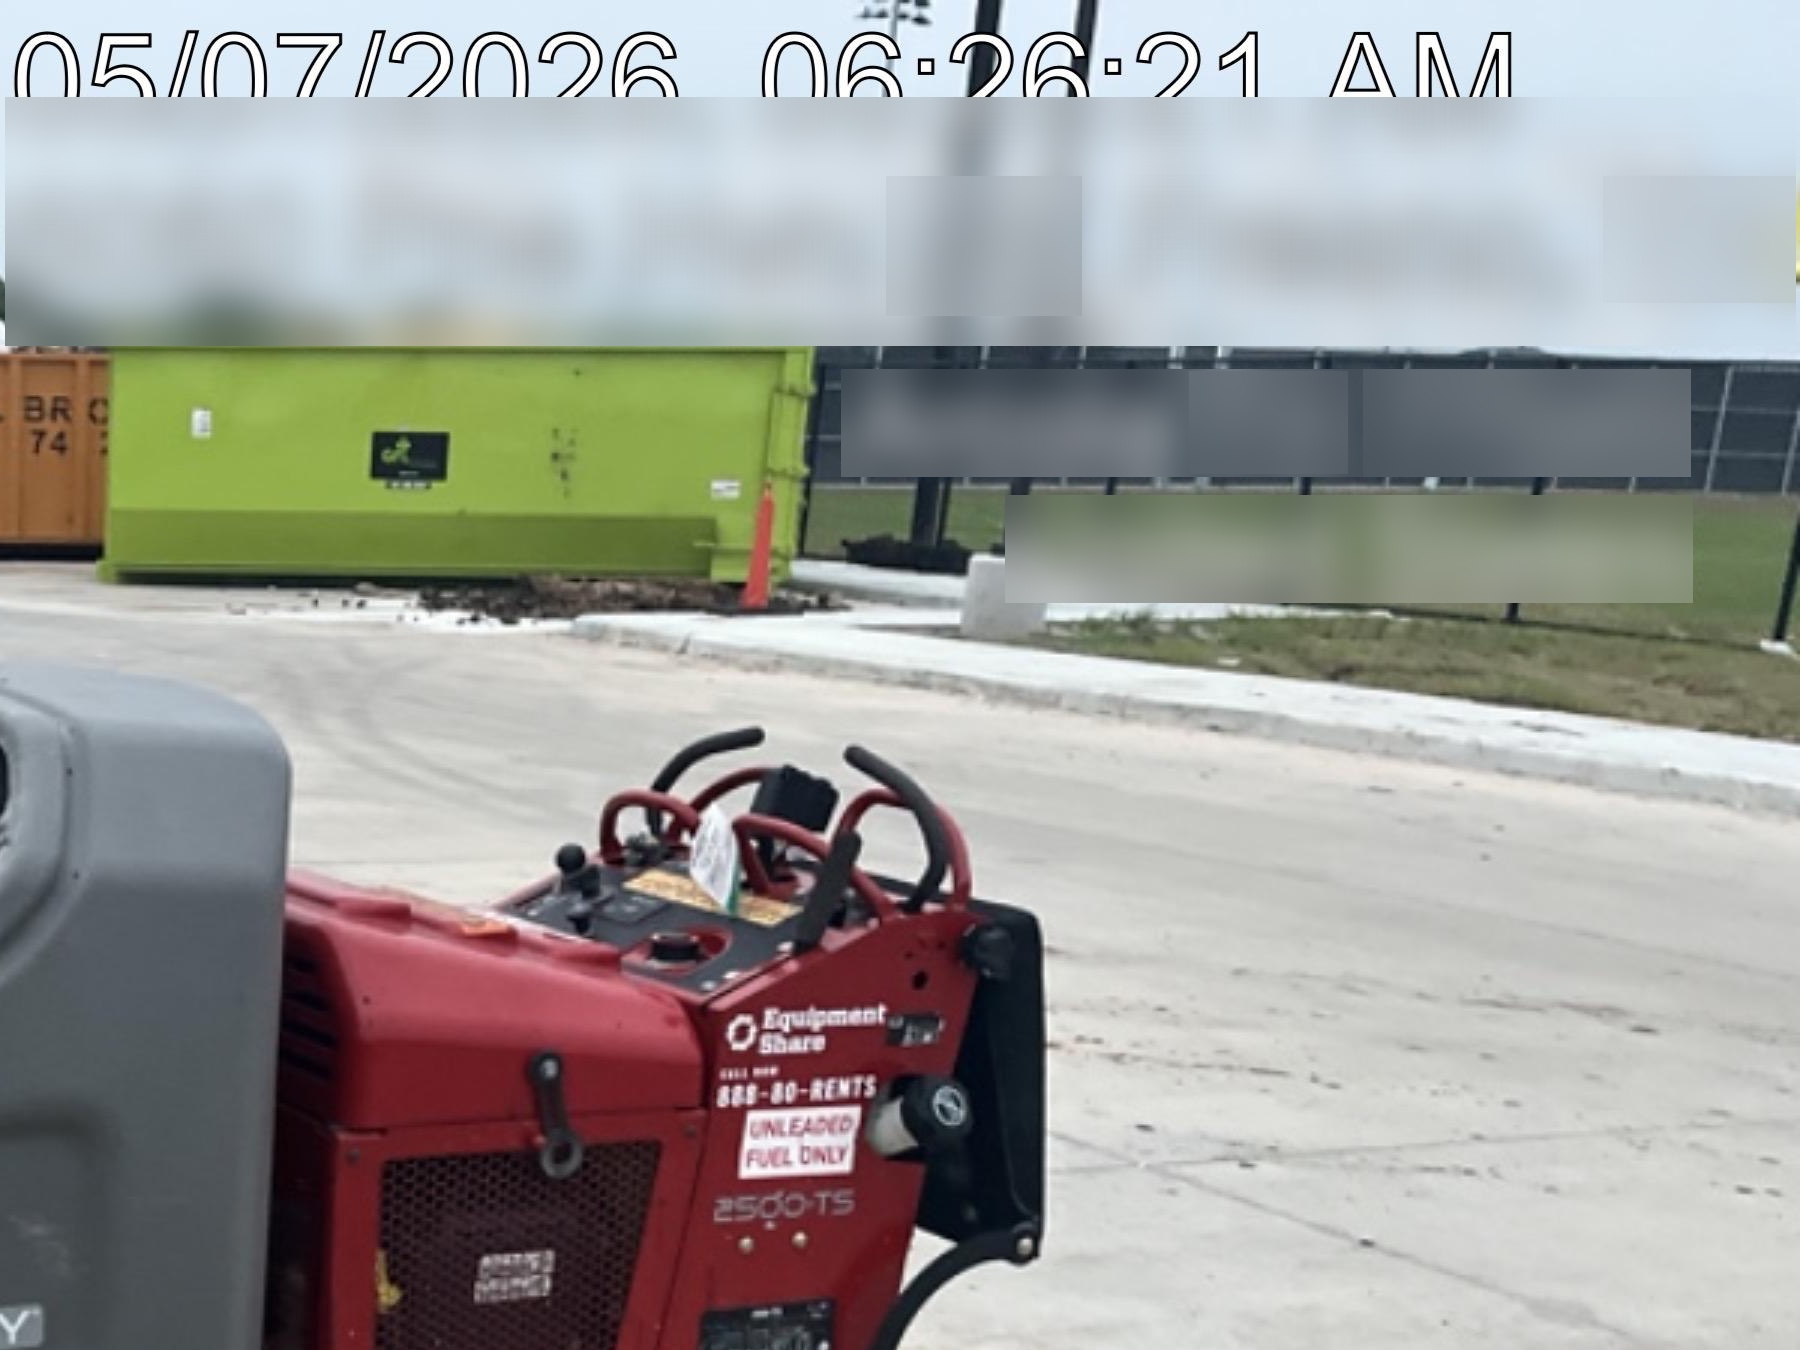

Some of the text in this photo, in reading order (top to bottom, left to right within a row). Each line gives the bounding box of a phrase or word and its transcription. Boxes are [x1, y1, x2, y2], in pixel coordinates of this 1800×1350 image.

[762, 1003, 887, 1032] Equipment
[758, 1033, 826, 1054] Share
[750, 1115, 852, 1139] UNLEADED
[747, 1145, 849, 1168] FUEL ONLY
